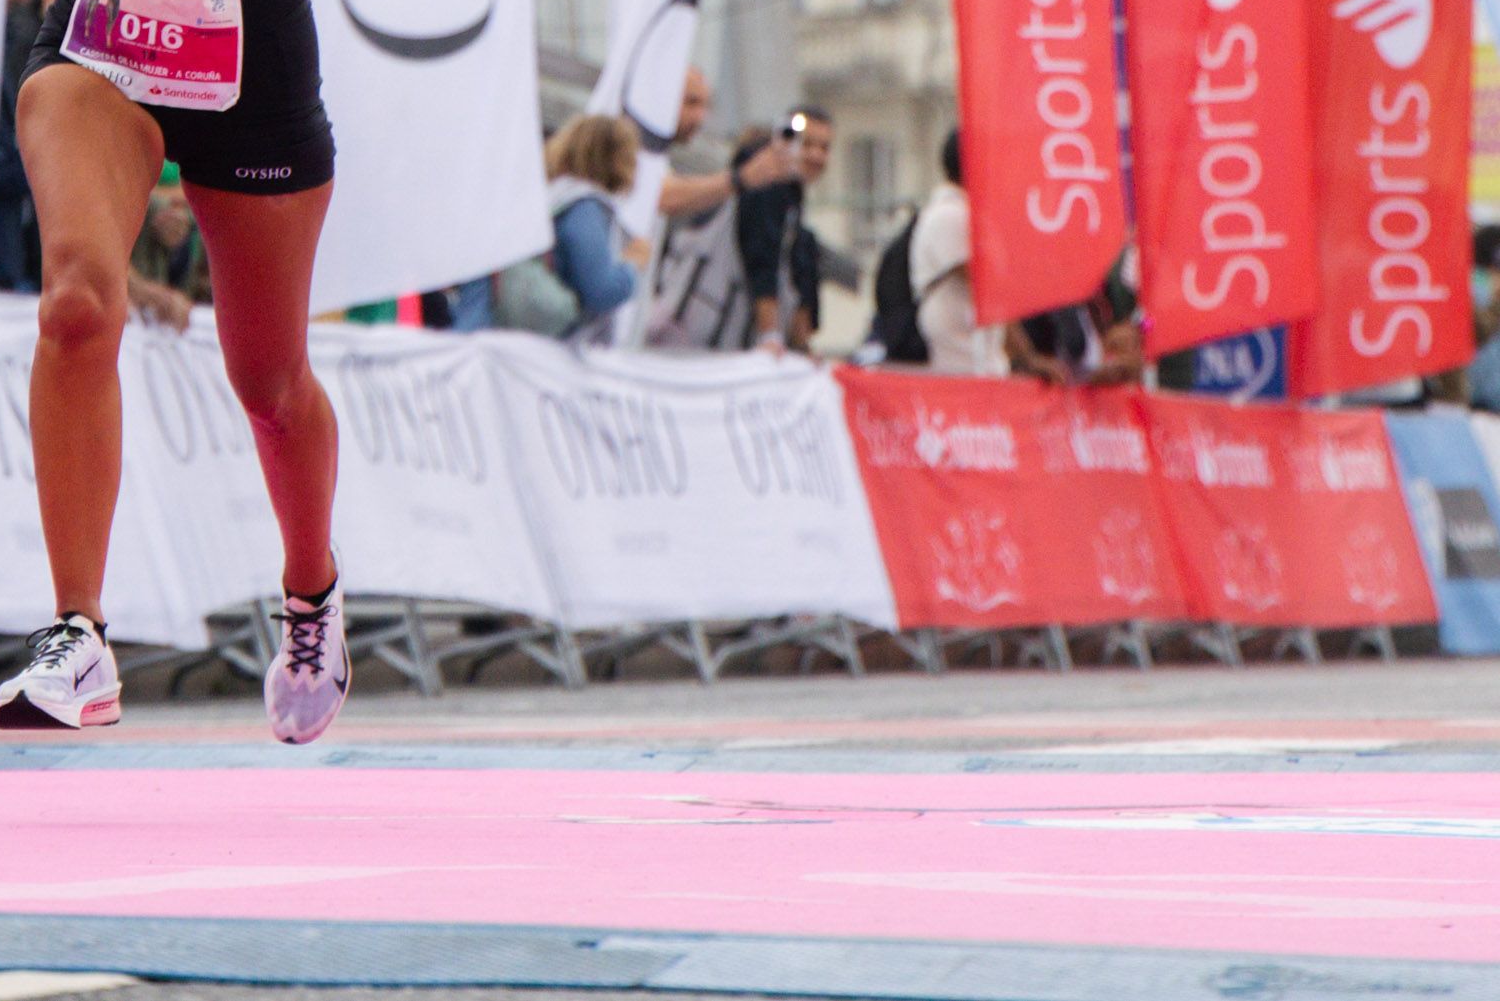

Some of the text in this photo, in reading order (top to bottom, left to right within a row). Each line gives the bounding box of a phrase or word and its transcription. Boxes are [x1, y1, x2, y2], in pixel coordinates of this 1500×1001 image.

[119, 13, 184, 50] 016
[139, 63, 168, 77] MUJER
[176, 70, 182, 79] A
[185, 70, 222, 81] CORUÑA
[163, 88, 217, 100] Santander
[235, 166, 292, 179] OYSHO
[1182, 22, 1288, 312] Sports
[1350, 80, 1450, 358] Sports
